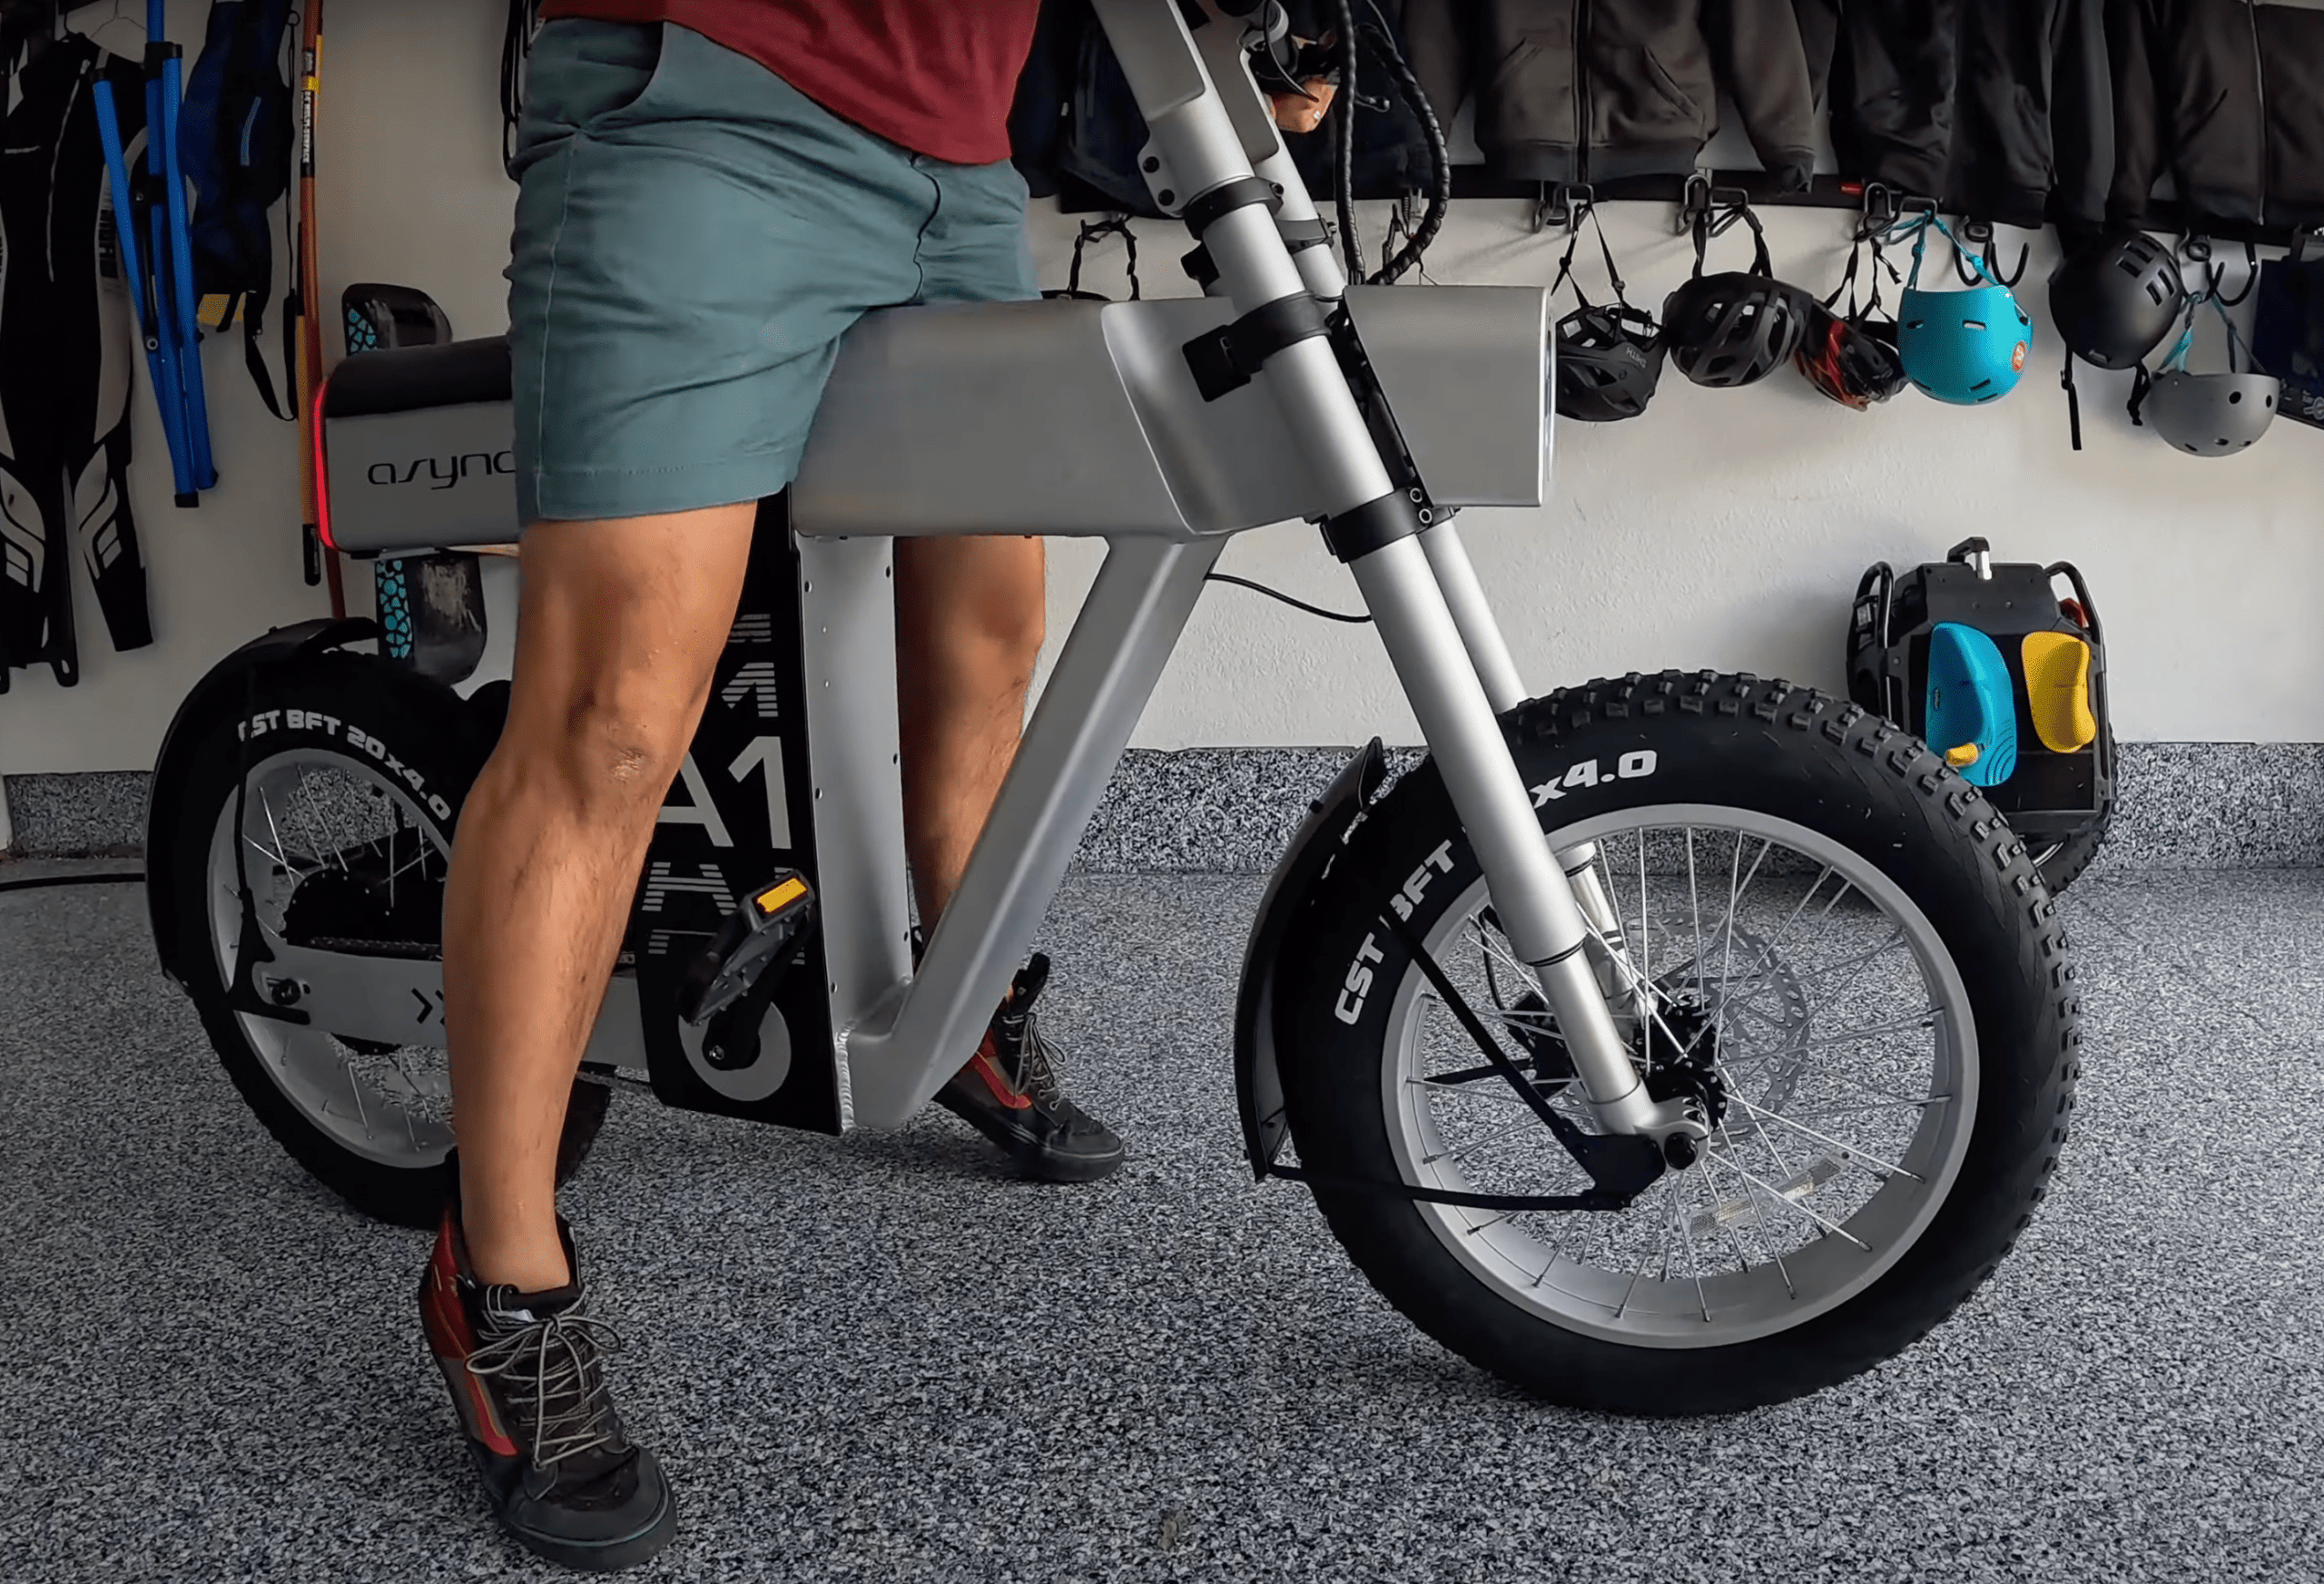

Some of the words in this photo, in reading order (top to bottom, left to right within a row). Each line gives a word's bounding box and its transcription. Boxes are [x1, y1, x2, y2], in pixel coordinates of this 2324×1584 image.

[286, 709, 341, 735] BFT
[1334, 931, 1384, 1025] CST
[1529, 750, 1657, 810] x4.0
